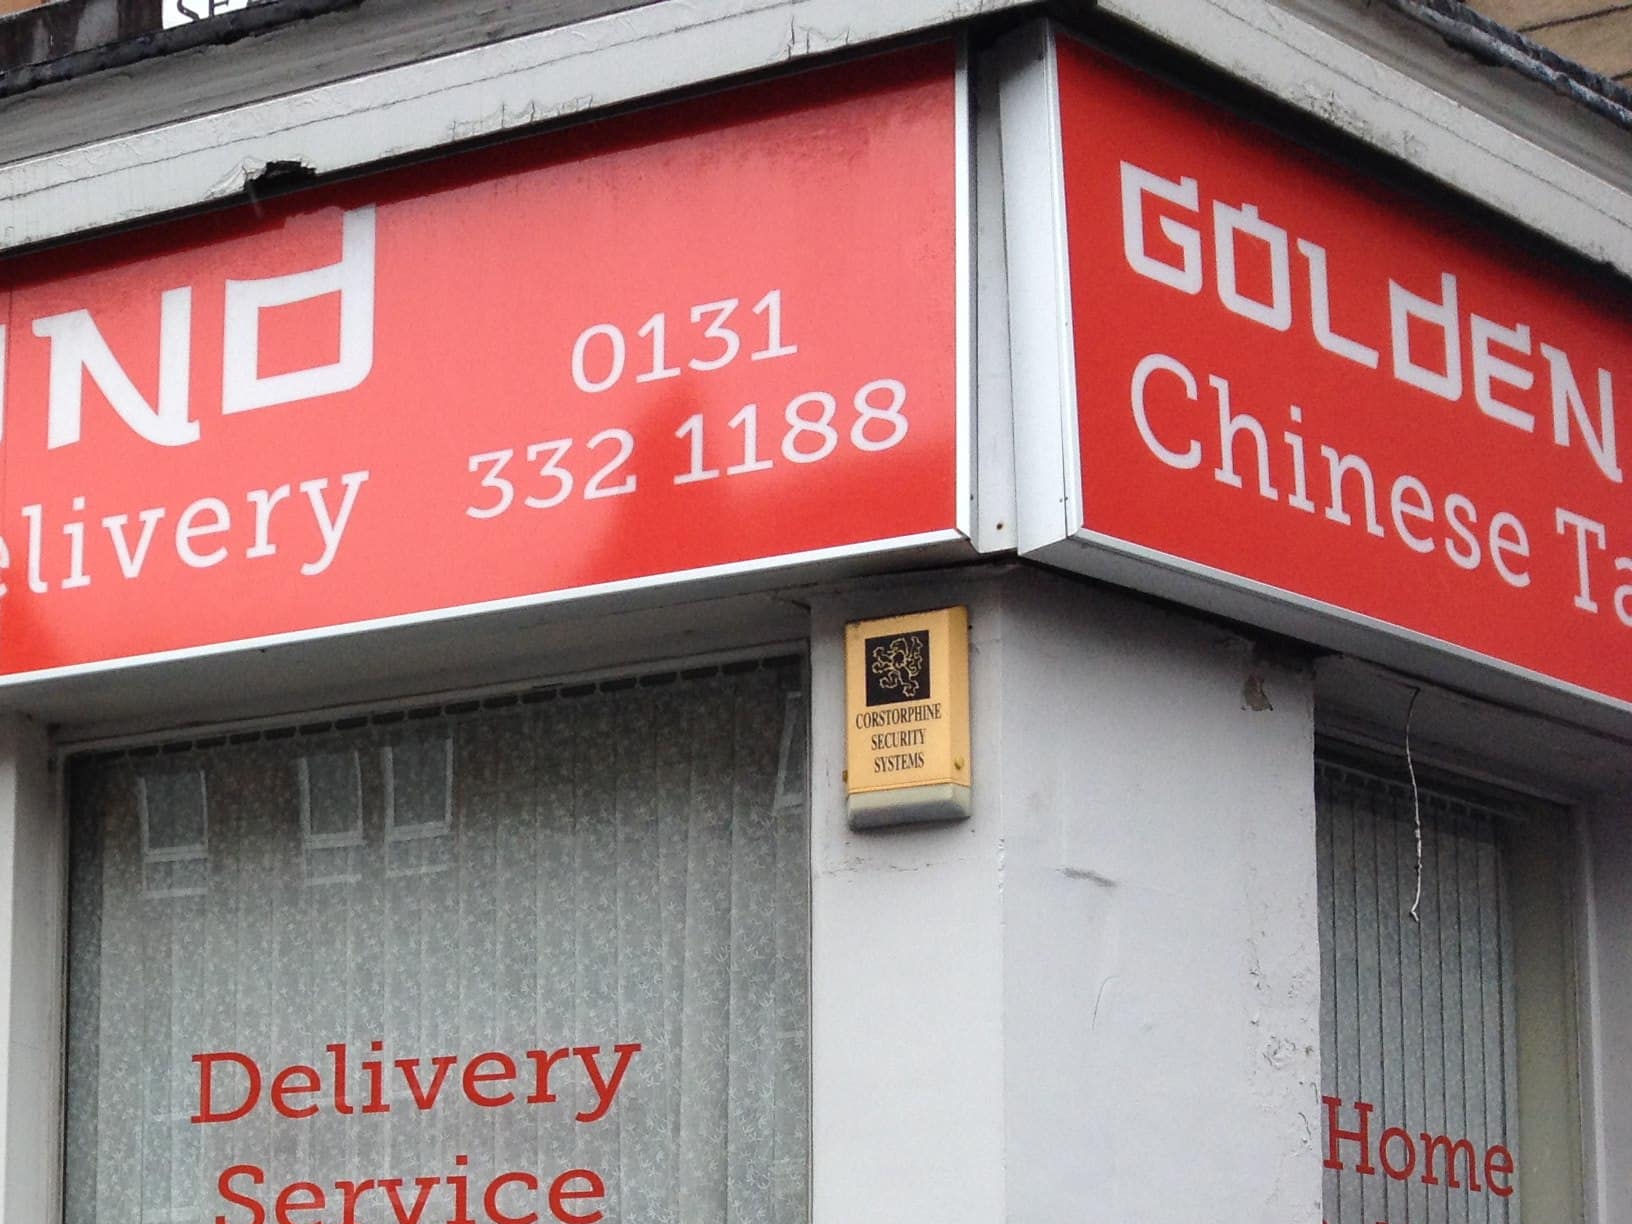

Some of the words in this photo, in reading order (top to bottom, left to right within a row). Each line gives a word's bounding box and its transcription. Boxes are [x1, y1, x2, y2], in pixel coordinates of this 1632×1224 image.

[571, 289, 797, 392] 0131
[466, 428, 636, 519] 332
[673, 379, 909, 487] 1188
[1130, 353, 1531, 588] Chinese
[856, 703, 942, 730] CORSTORPHINE
[871, 728, 926, 751] SECURITY
[874, 752, 925, 774] SYSTEMS
[190, 1040, 642, 1124] Delivery
[1322, 1095, 1514, 1197] Home
